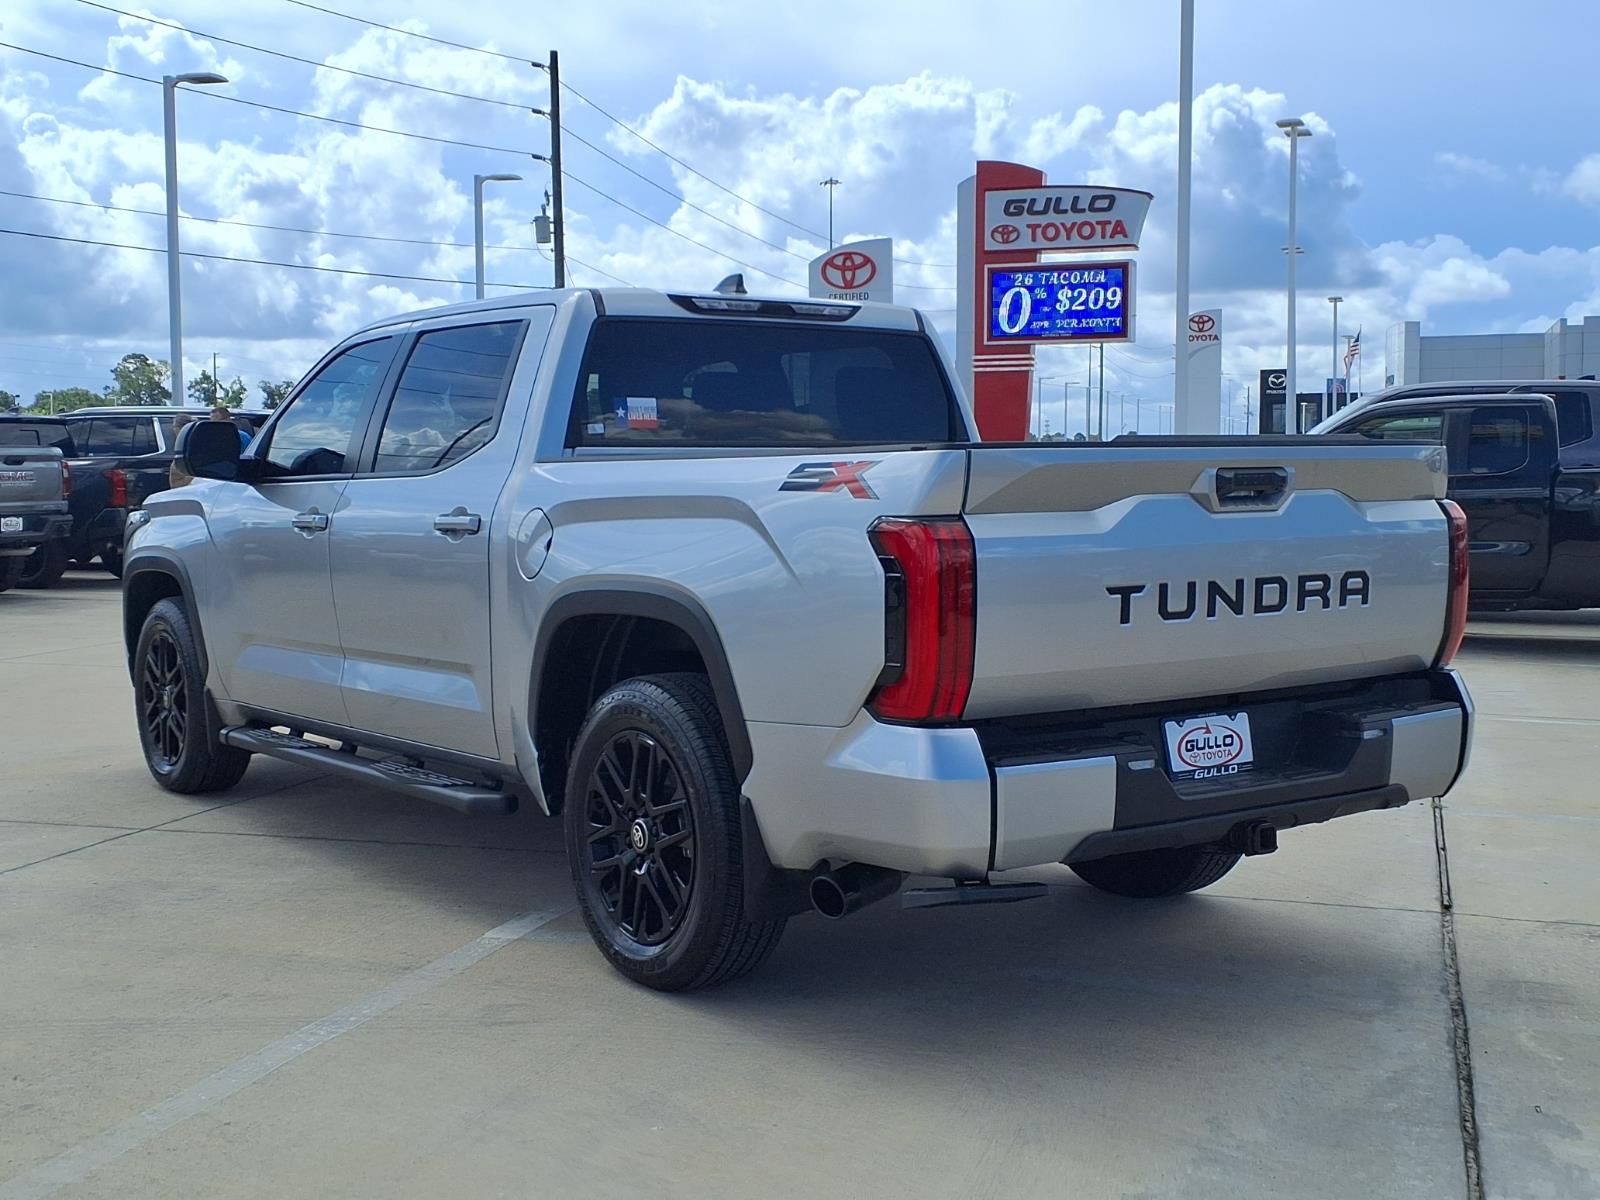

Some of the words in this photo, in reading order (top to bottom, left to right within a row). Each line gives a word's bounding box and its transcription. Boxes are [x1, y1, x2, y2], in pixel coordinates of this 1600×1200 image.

[1003, 194, 1116, 217] GULLO
[1026, 219, 1128, 242] TOYOTA
[1039, 270, 1106, 285] TACOMA
[828, 291, 870, 301] CERTIFIED
[1055, 286, 1121, 314] $209
[1188, 334, 1220, 343] OYOTA
[1105, 570, 1370, 625] TUNDRA
[1185, 734, 1234, 753] GULLO
[1202, 750, 1233, 761] TOYOTA
[1194, 764, 1238, 779] GULLO
